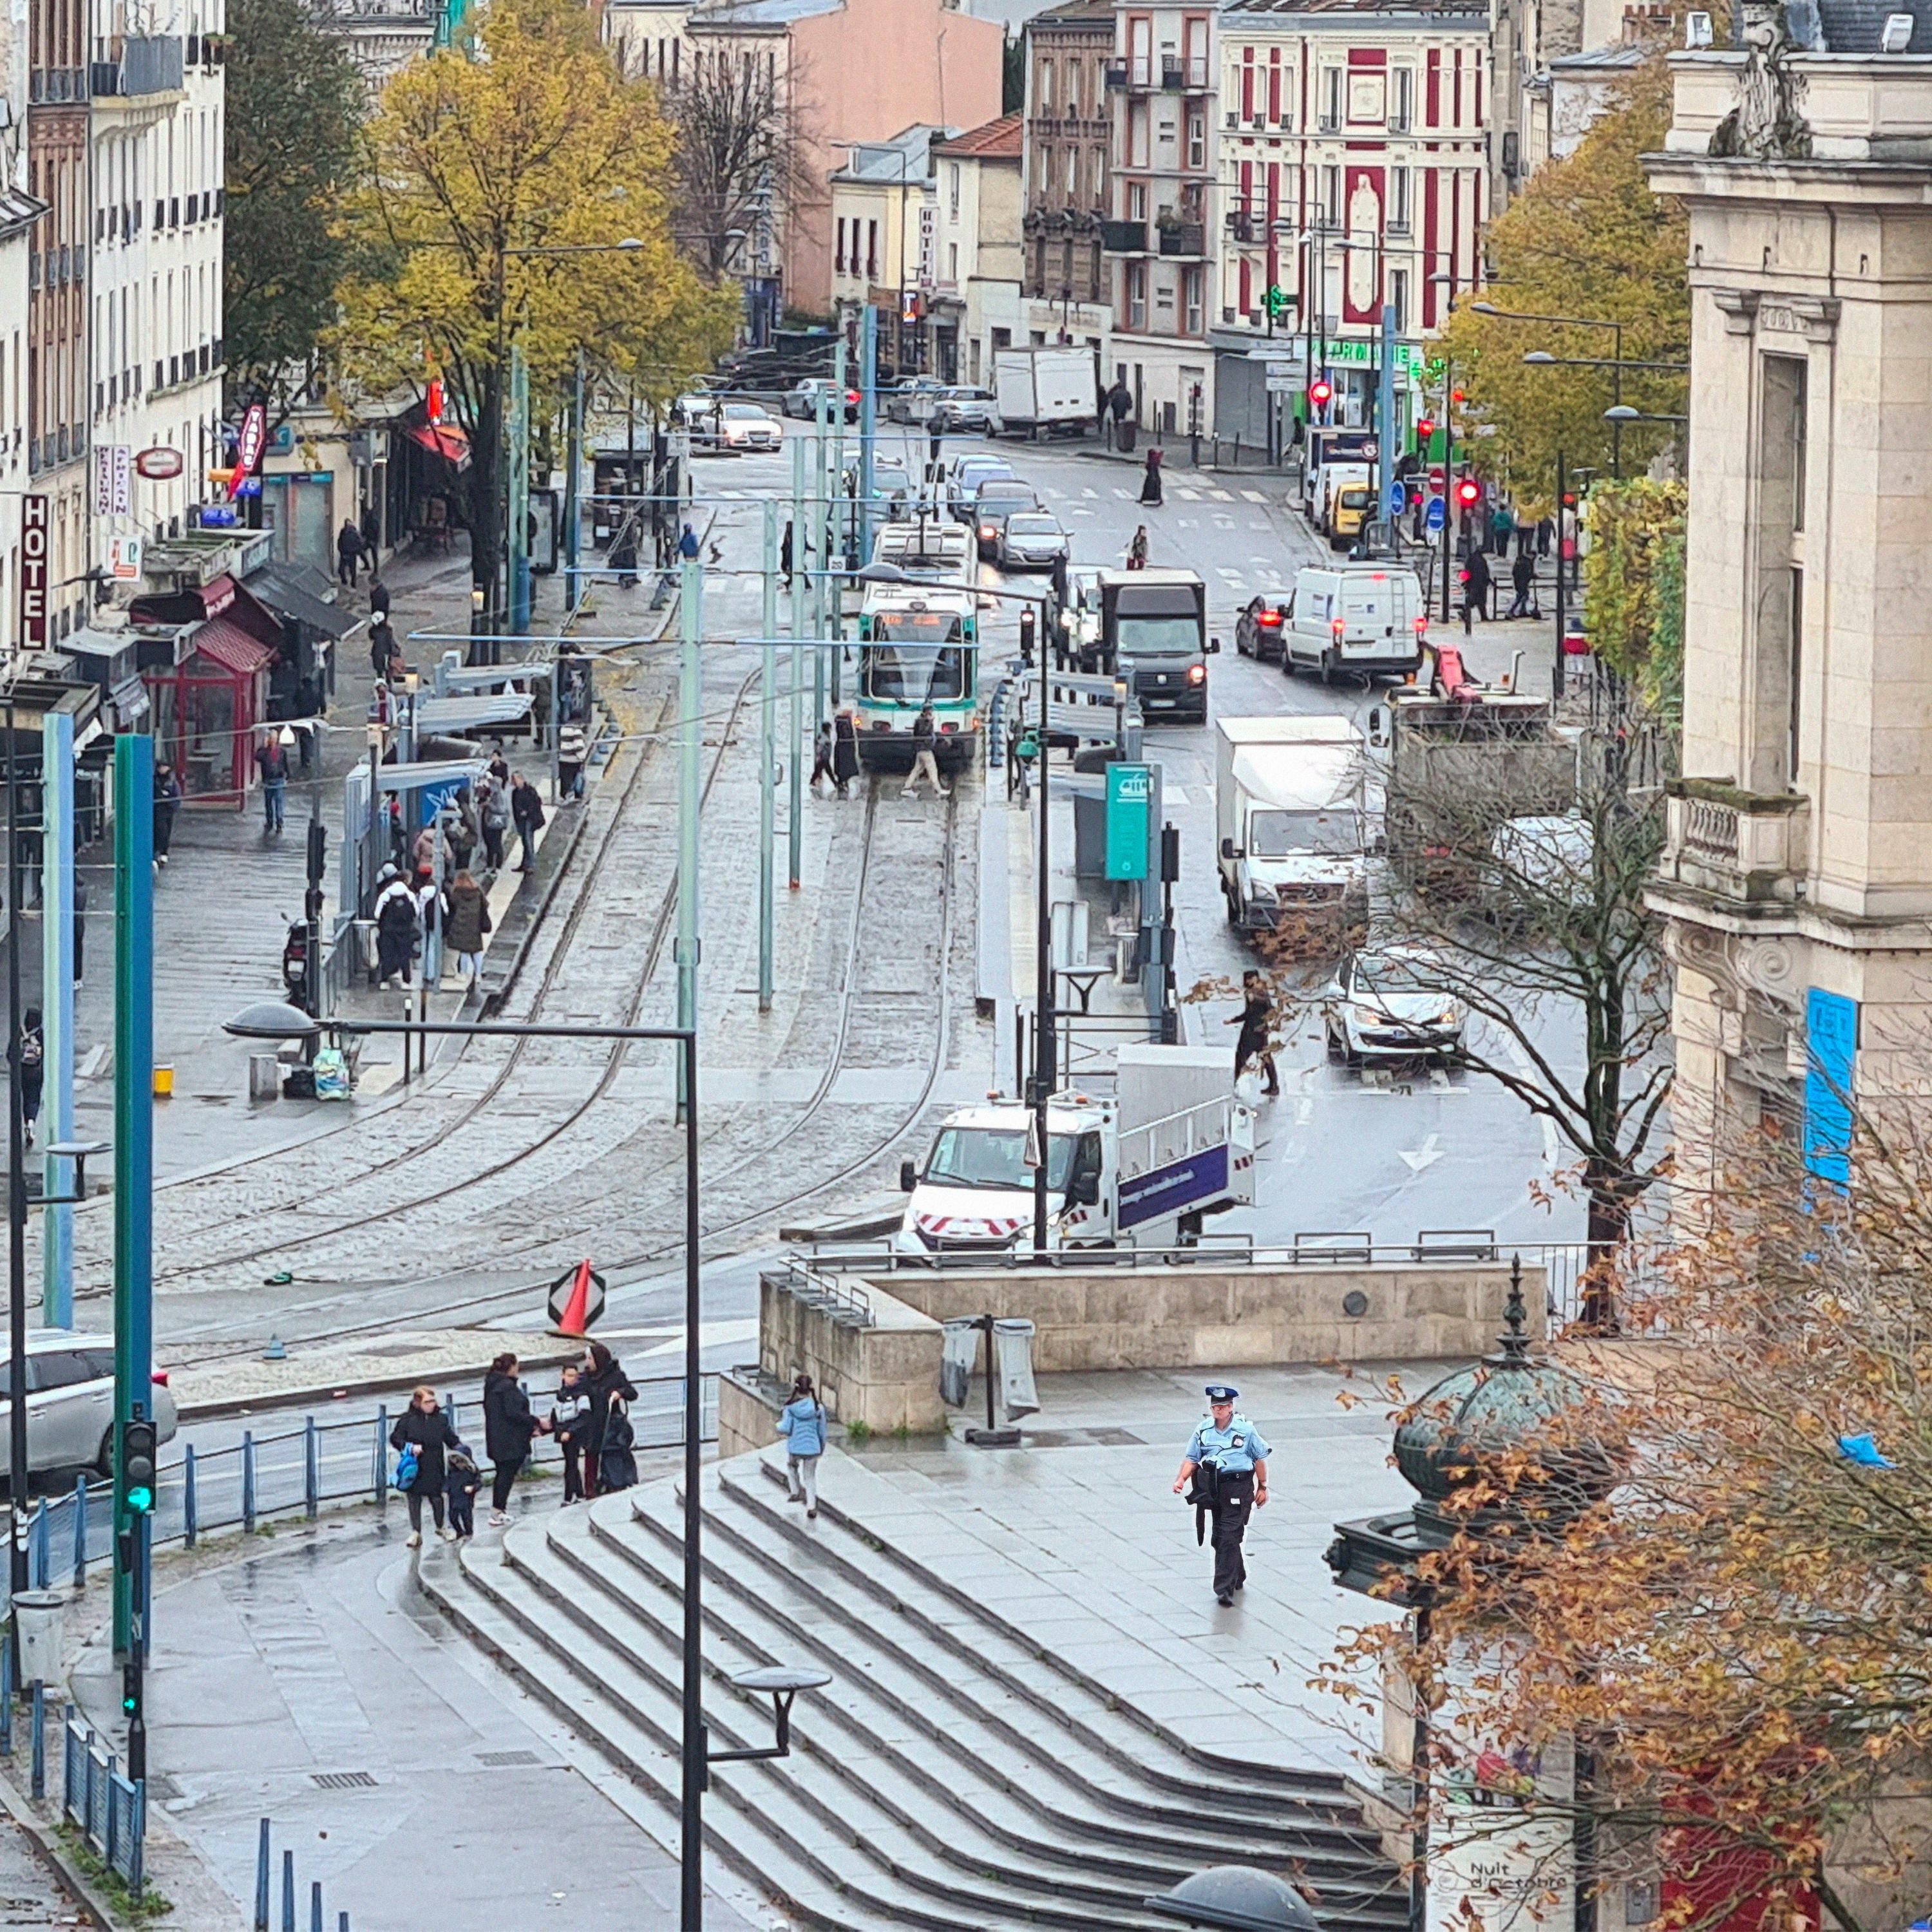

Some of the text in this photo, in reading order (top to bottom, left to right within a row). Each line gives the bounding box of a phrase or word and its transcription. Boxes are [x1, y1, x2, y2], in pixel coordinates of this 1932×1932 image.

[1311, 341, 1410, 363] PARMIE
[243, 410, 261, 466] TABAC
[24, 498, 45, 647] HOTEL
[1471, 1861, 1510, 1875] Nuit
